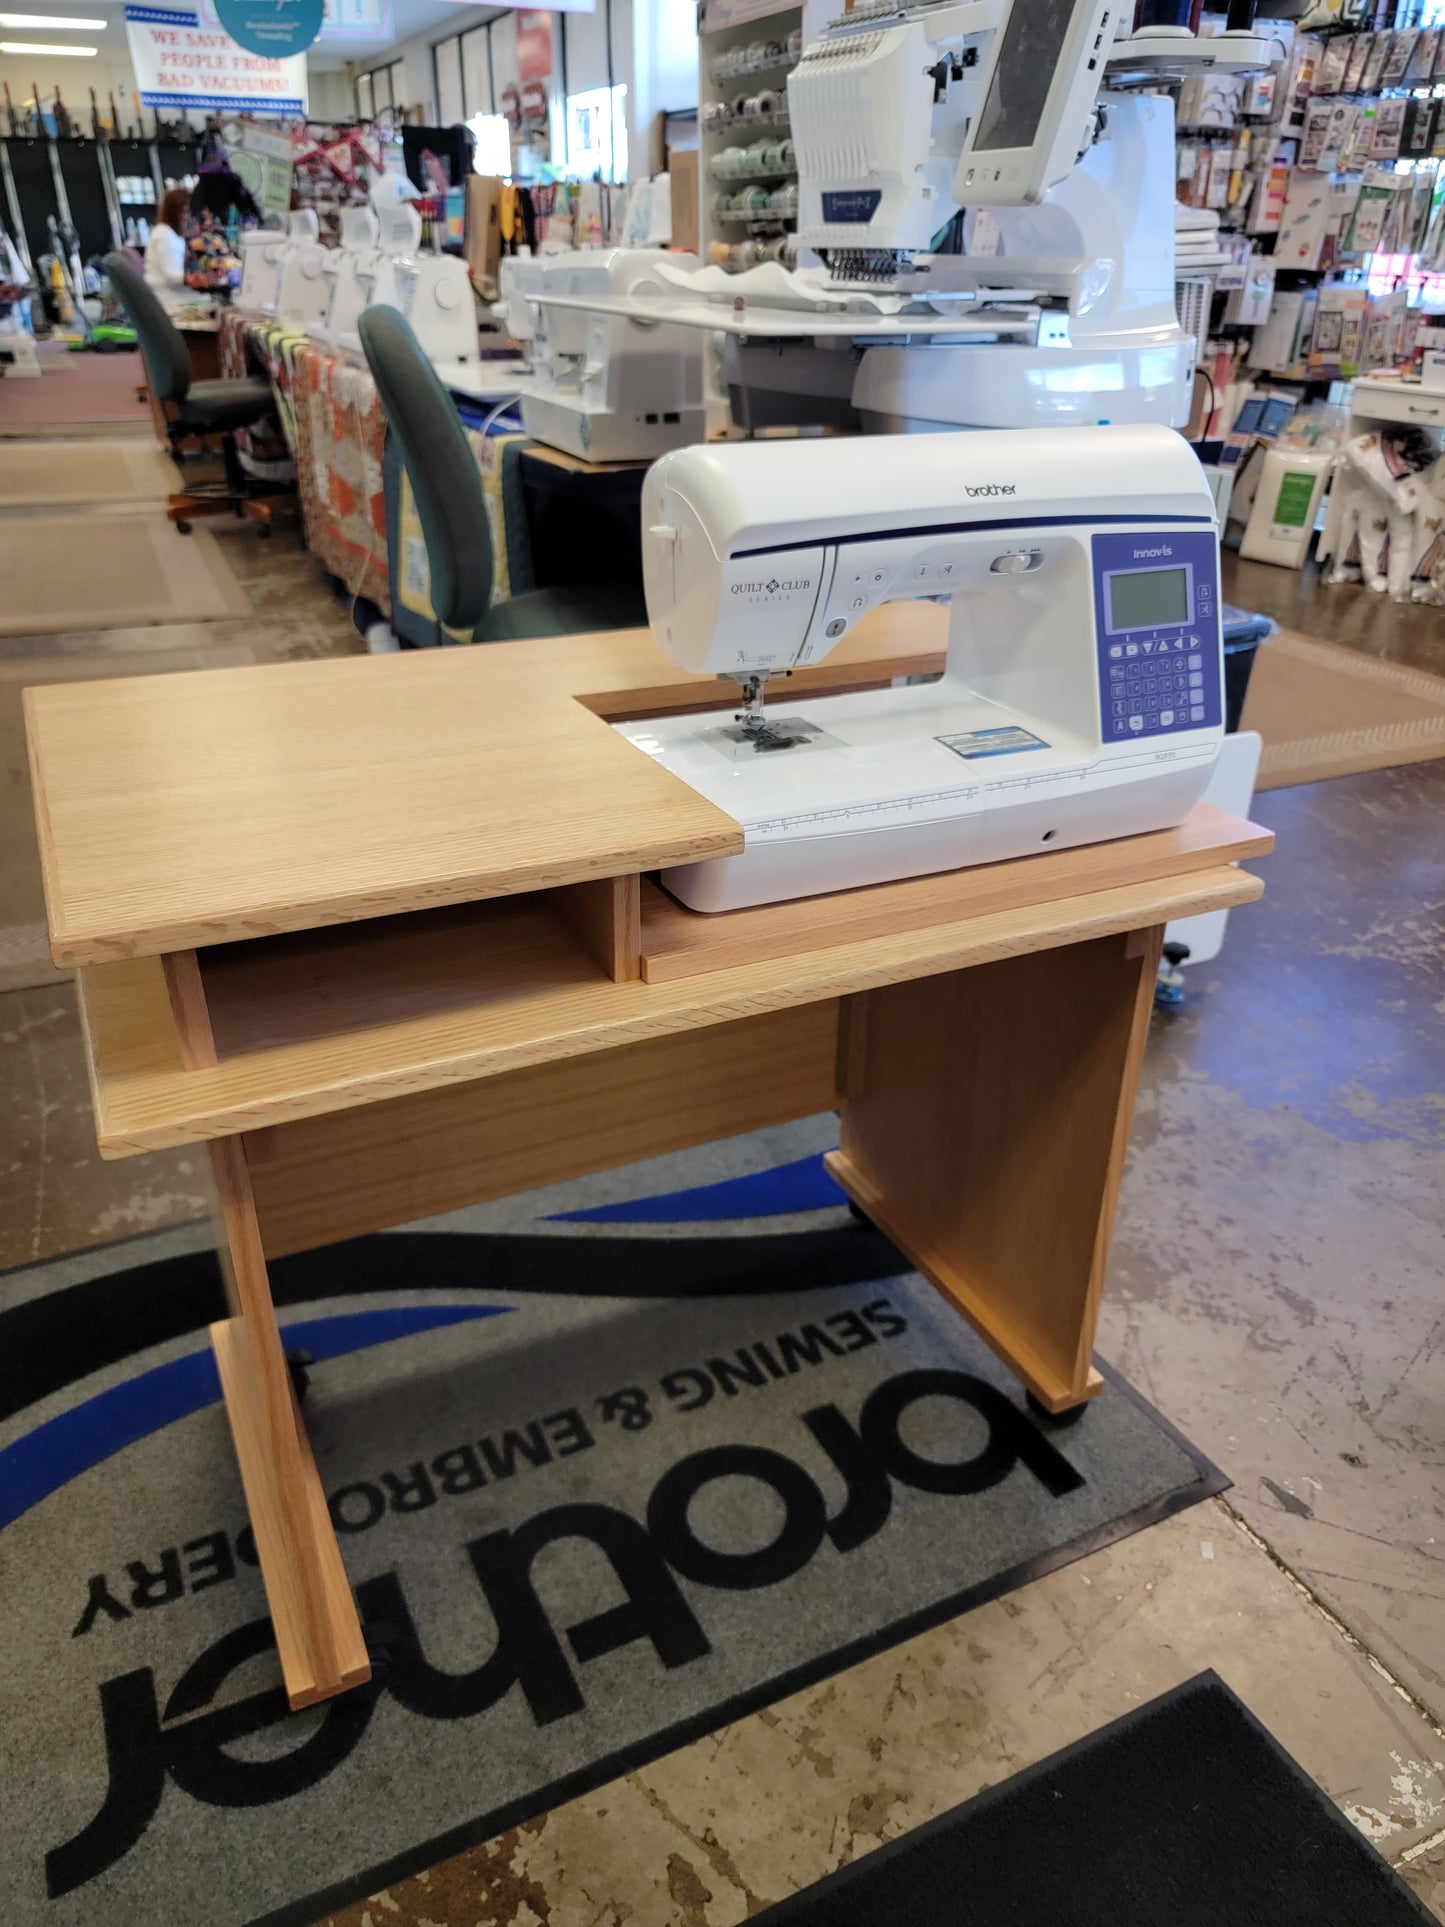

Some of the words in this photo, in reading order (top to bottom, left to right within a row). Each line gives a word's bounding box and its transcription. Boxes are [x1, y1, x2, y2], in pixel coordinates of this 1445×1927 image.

[150, 30, 182, 47] WE
[185, 33, 231, 49] SAVE
[160, 52, 226, 68] PEOPLE
[232, 56, 282, 73] FROM
[157, 73, 194, 88] BAD
[964, 484, 1016, 497] brother
[731, 582, 764, 595] QUILT
[781, 580, 810, 591] CLUB
[661, 1299, 908, 1411] SEWING
[595, 1386, 653, 1432] &
[72, 1407, 596, 1638] EMBROERY
[45, 1368, 1086, 1900] brother
